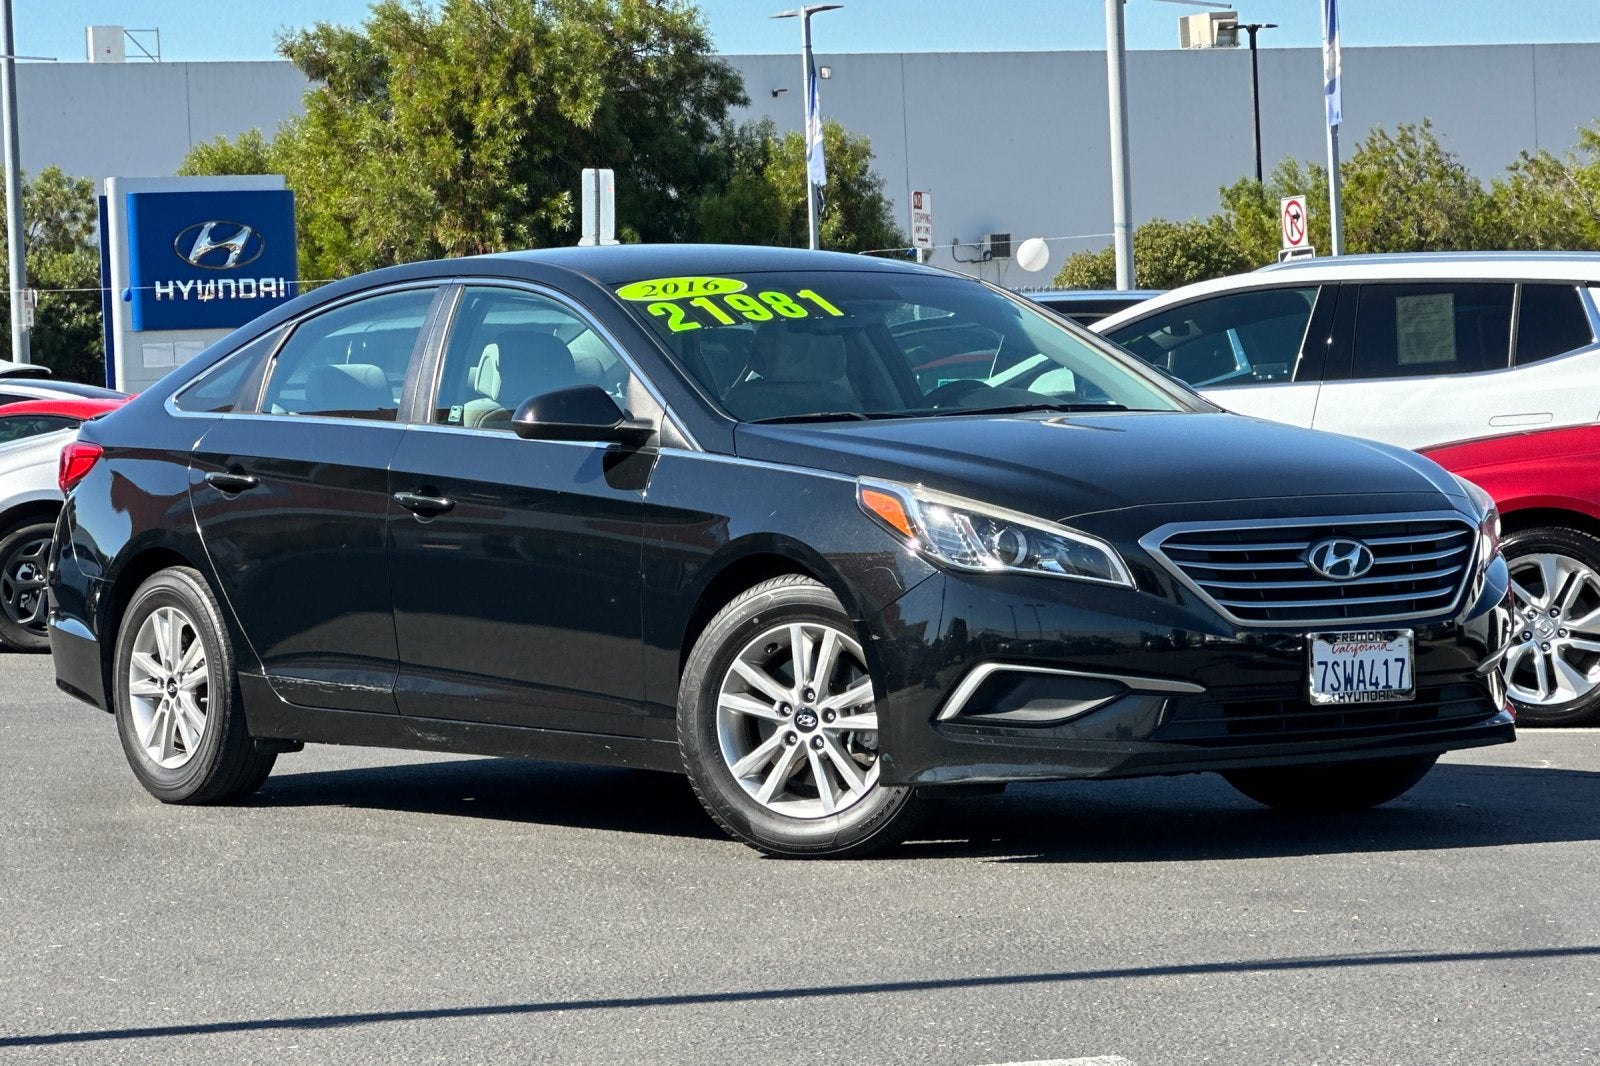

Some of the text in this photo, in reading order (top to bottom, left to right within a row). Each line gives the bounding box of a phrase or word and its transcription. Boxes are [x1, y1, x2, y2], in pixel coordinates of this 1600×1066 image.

[154, 277, 286, 302] HYUNDAI
[641, 279, 721, 298] 2016
[647, 289, 845, 333] 21981
[1331, 643, 1394, 658] California
[1317, 657, 1406, 692] 7SWA417
[1338, 689, 1390, 703] HYUNDAI
